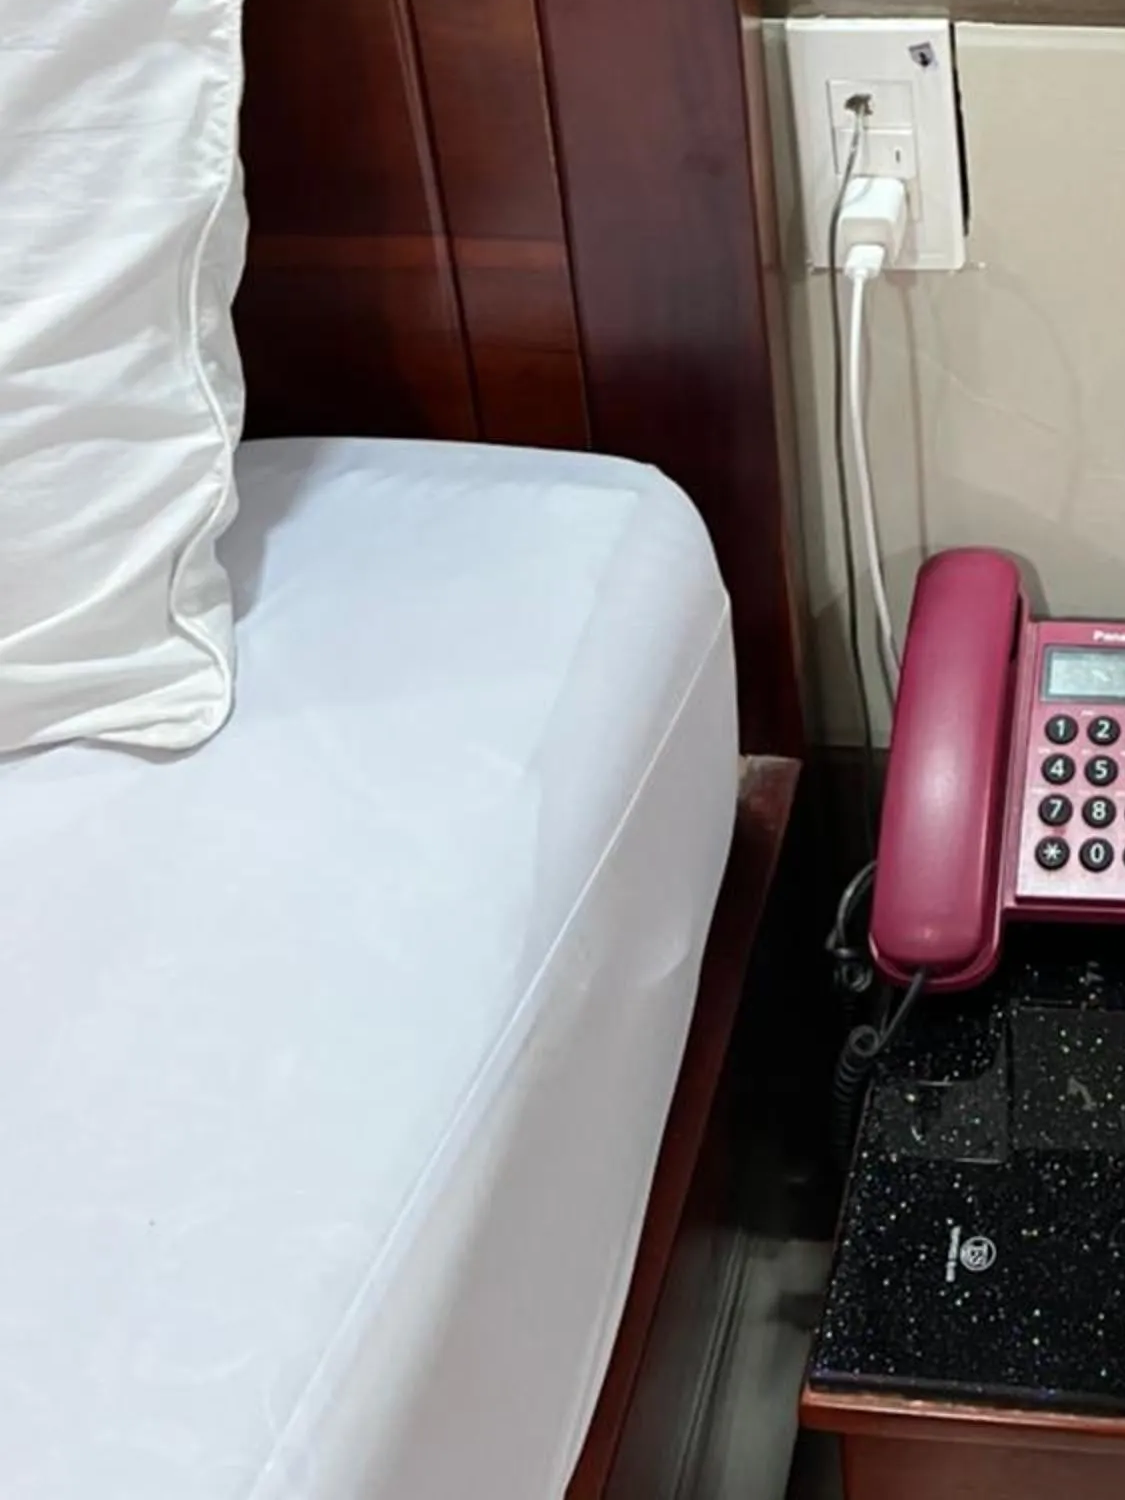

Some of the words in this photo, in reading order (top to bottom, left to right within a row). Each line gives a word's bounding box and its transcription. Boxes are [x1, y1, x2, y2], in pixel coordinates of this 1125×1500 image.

[1056, 718, 1066, 738] 1
[1097, 720, 1111, 739] 2
[1050, 757, 1065, 777] 4
[1095, 760, 1108, 779] 5
[1048, 799, 1063, 819] 7
[1091, 801, 1106, 821] 8
[1089, 843, 1105, 863] 0
